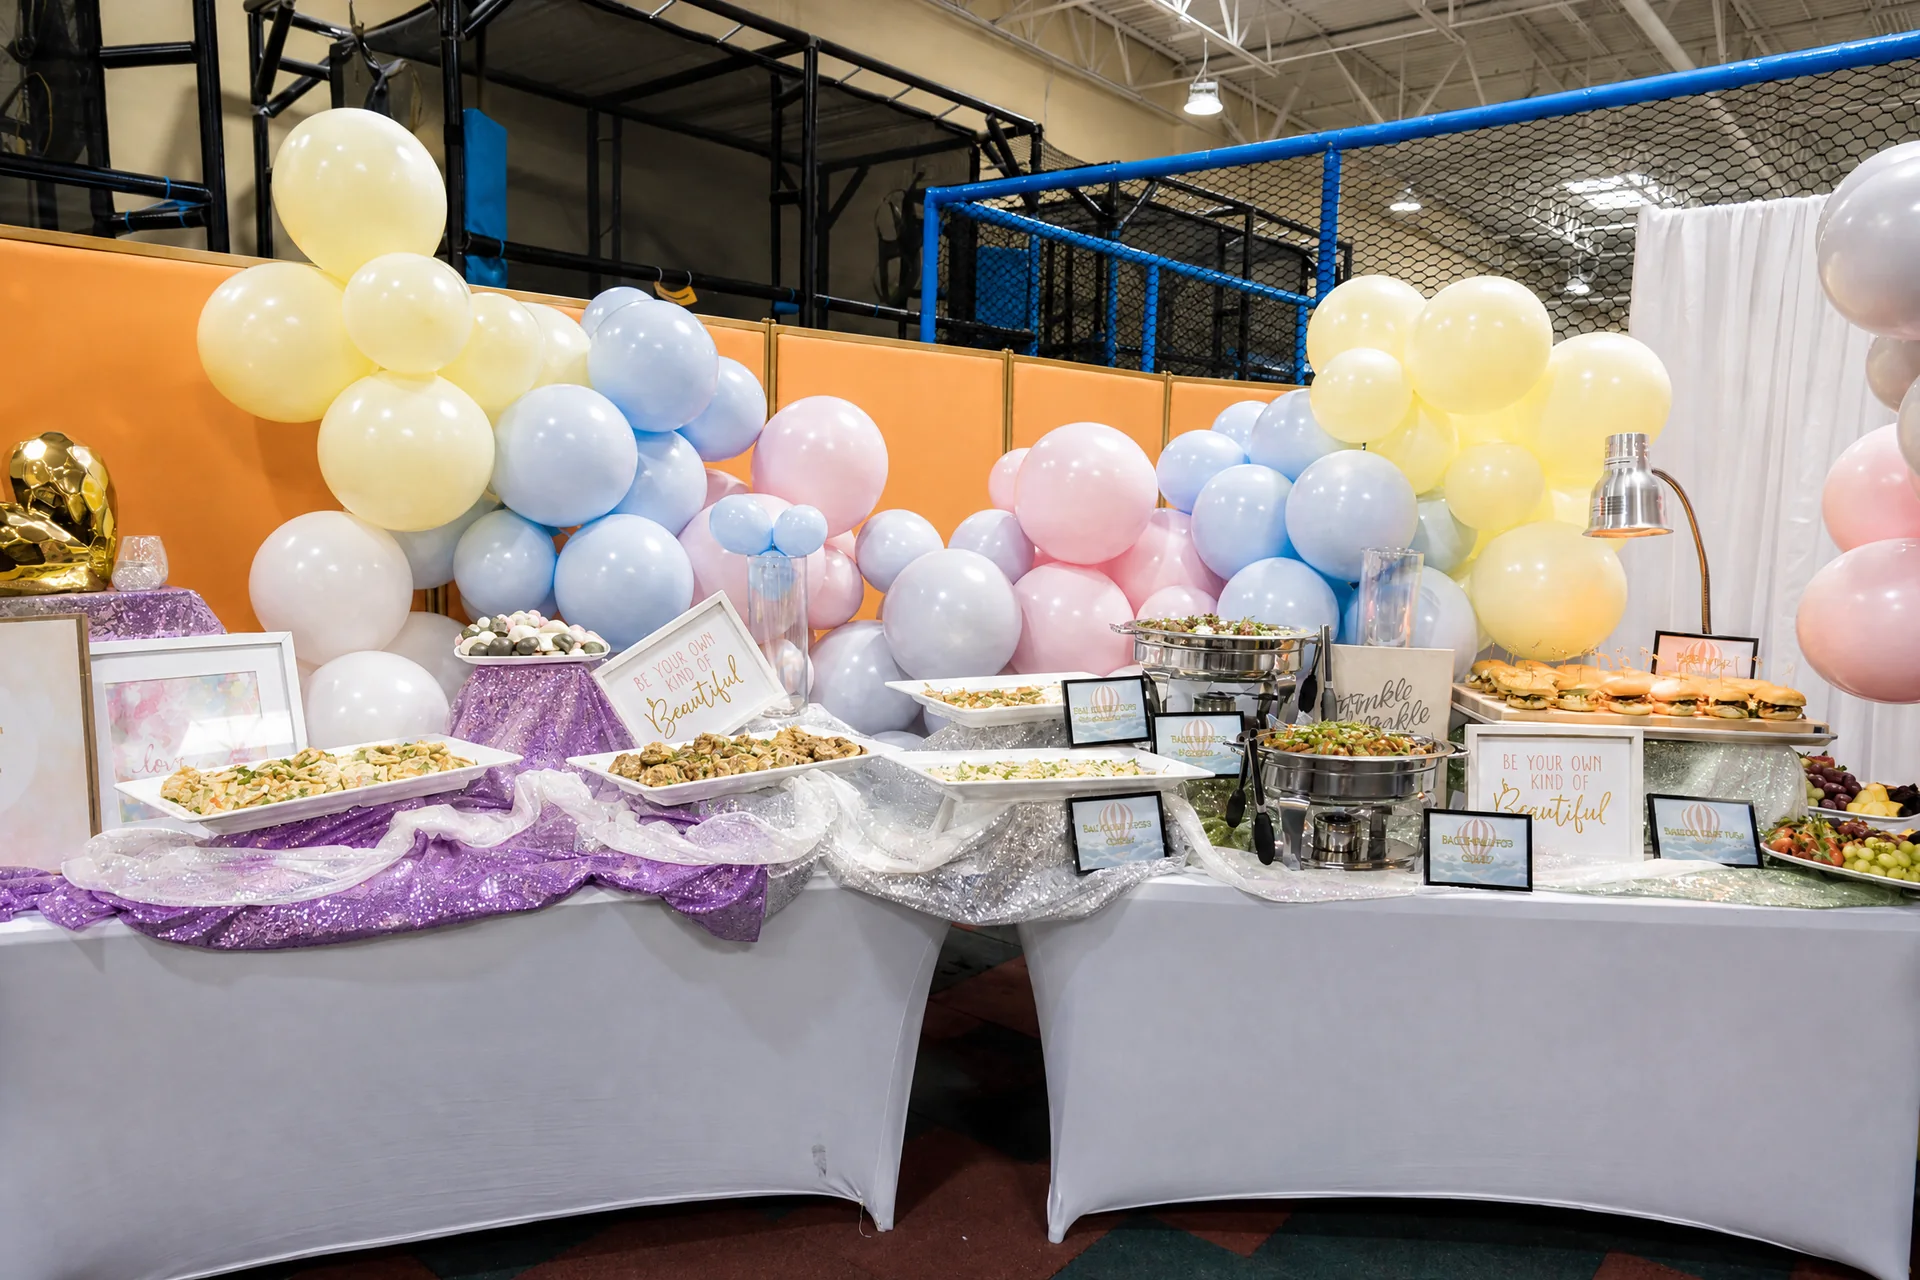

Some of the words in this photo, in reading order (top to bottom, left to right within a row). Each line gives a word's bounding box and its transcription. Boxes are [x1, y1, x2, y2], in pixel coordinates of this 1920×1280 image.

[633, 672, 653, 692] BE
[652, 651, 688, 678] YOUR
[688, 631, 716, 656] OWN
[665, 667, 695, 693] KIND
[697, 653, 713, 673] OF
[644, 654, 744, 740] Beautiful
[1503, 753, 1518, 770] BE
[1526, 754, 1563, 772] YOUR
[1571, 755, 1602, 772] OWN
[1531, 774, 1563, 790] KIND
[1572, 774, 1589, 790] OF
[1493, 777, 1612, 834] Beautiful
